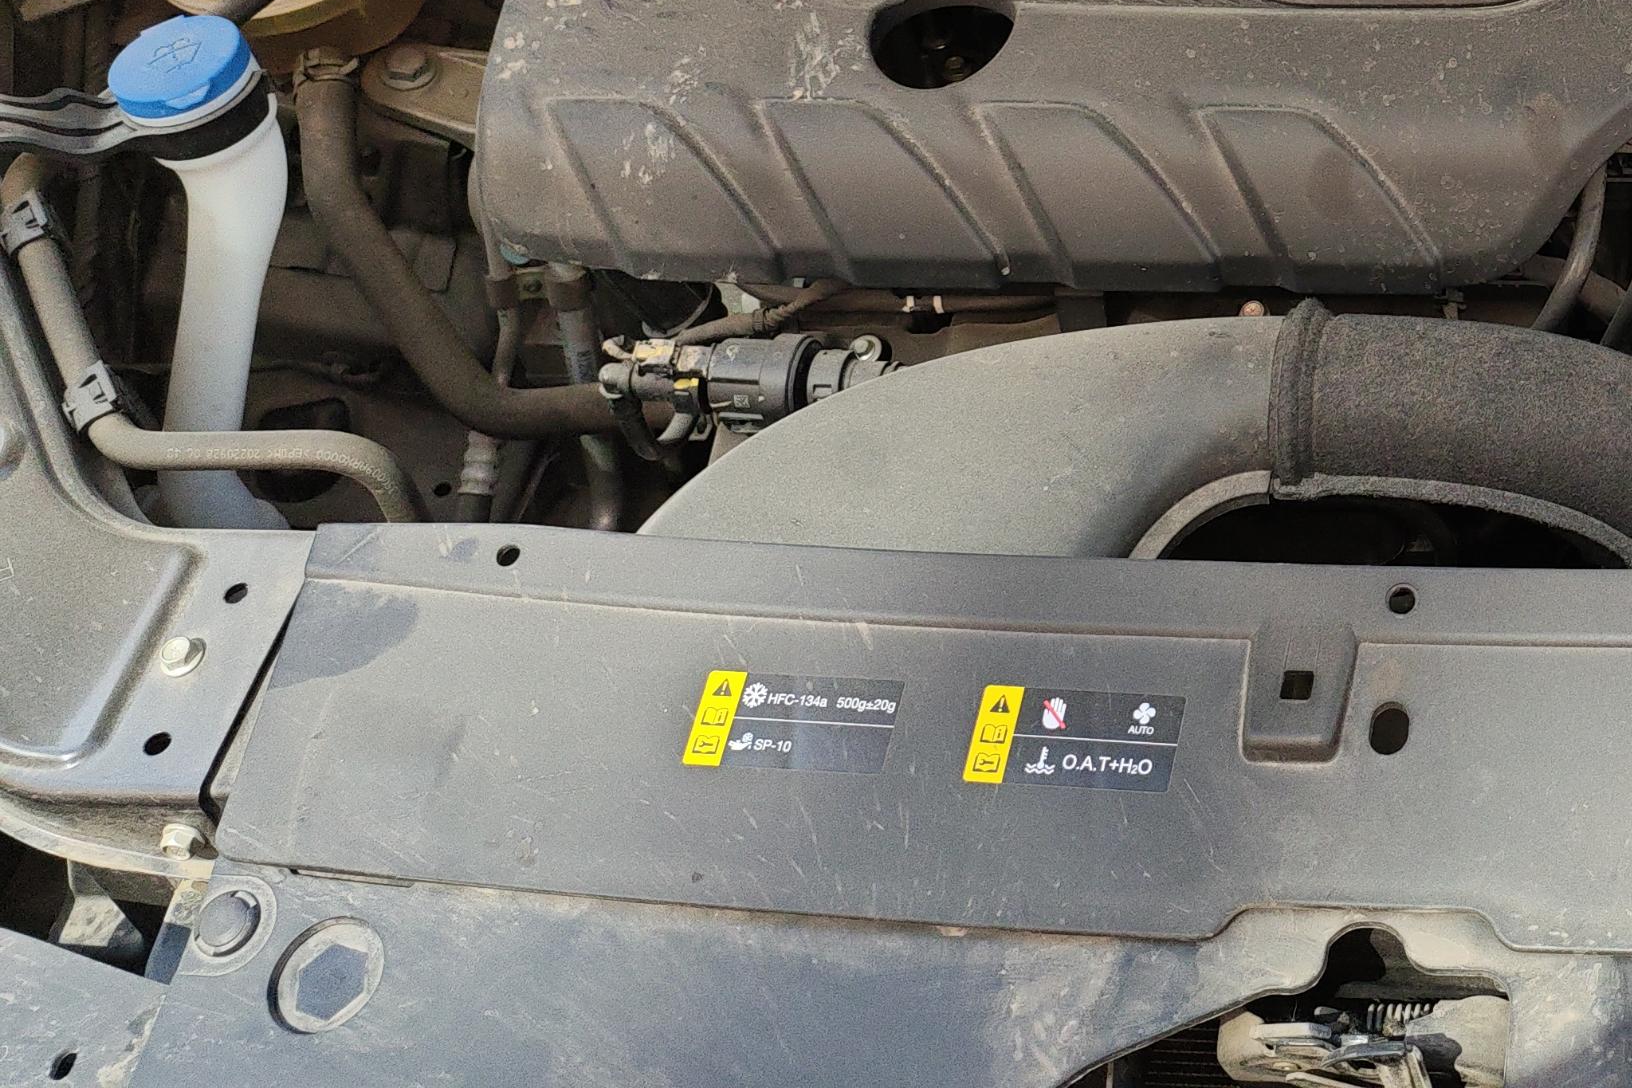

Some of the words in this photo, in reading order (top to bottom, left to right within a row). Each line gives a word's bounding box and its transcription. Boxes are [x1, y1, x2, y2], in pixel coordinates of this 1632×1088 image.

[767, 693, 828, 708] HFC-134a
[836, 696, 897, 714] 500g±20g
[1128, 725, 1154, 735] AUTO
[753, 738, 792, 753] SP-10
